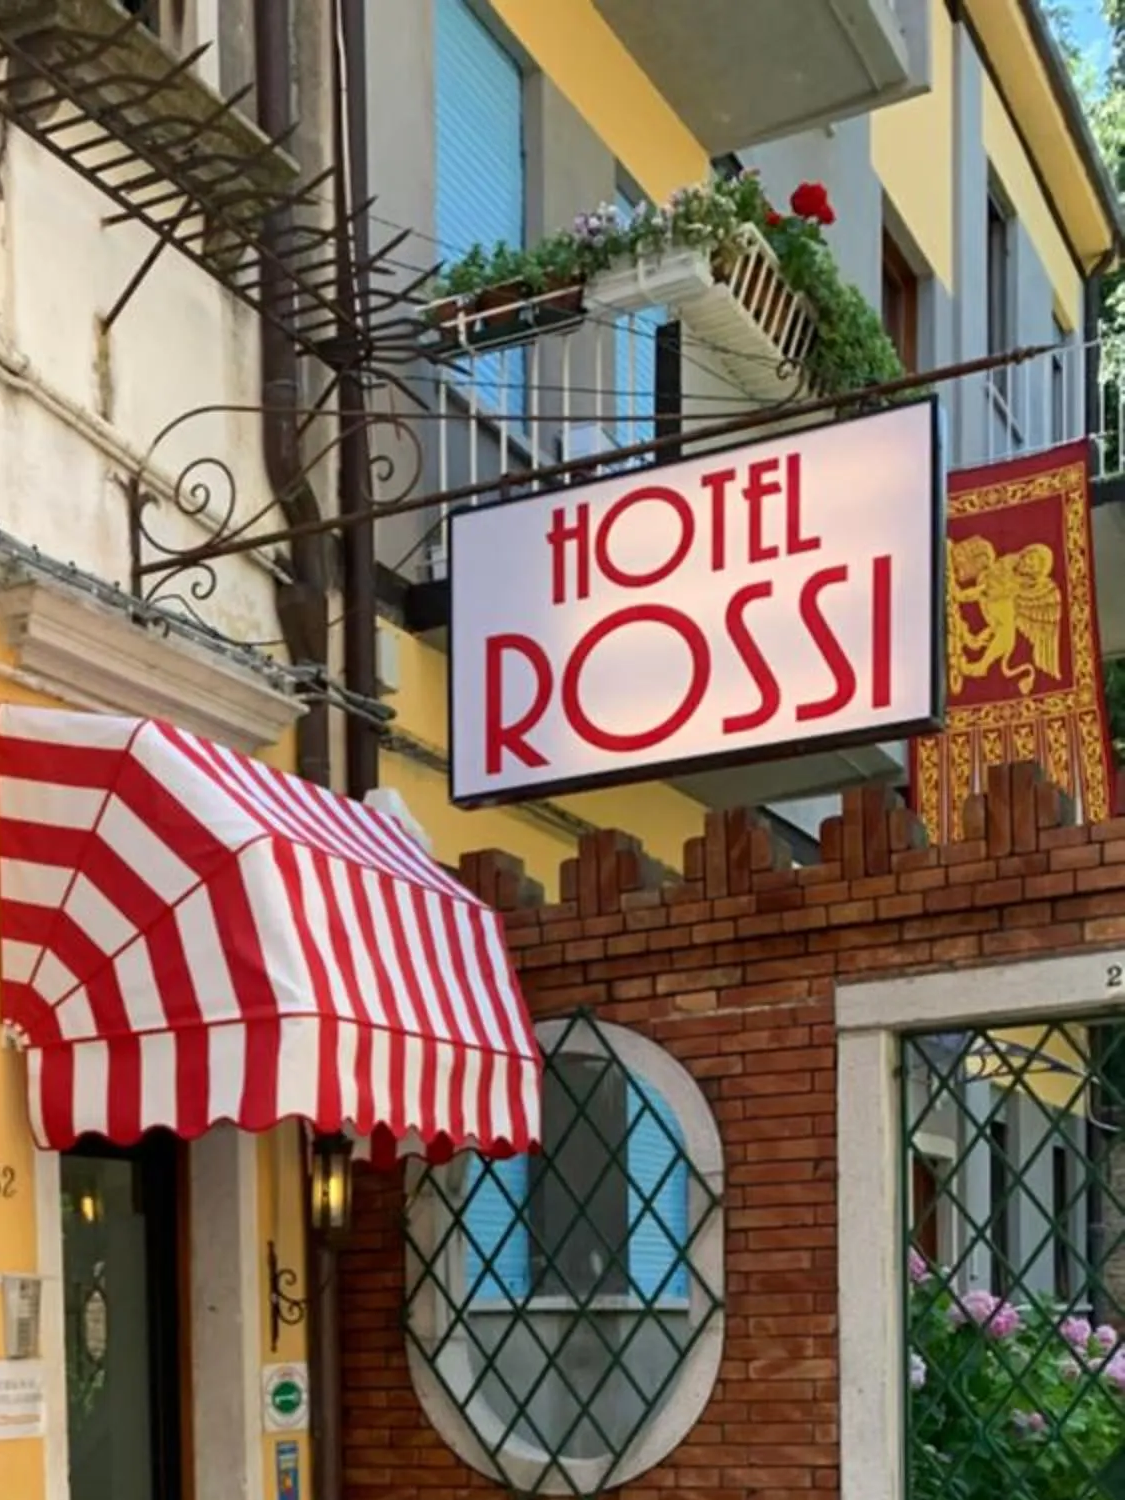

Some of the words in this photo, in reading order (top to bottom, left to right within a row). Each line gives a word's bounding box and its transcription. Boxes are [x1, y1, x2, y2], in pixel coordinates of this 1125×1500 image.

[545, 452, 821, 606] HOTEL
[485, 554, 892, 775] ROSSI
[1106, 964, 1123, 988] 2
